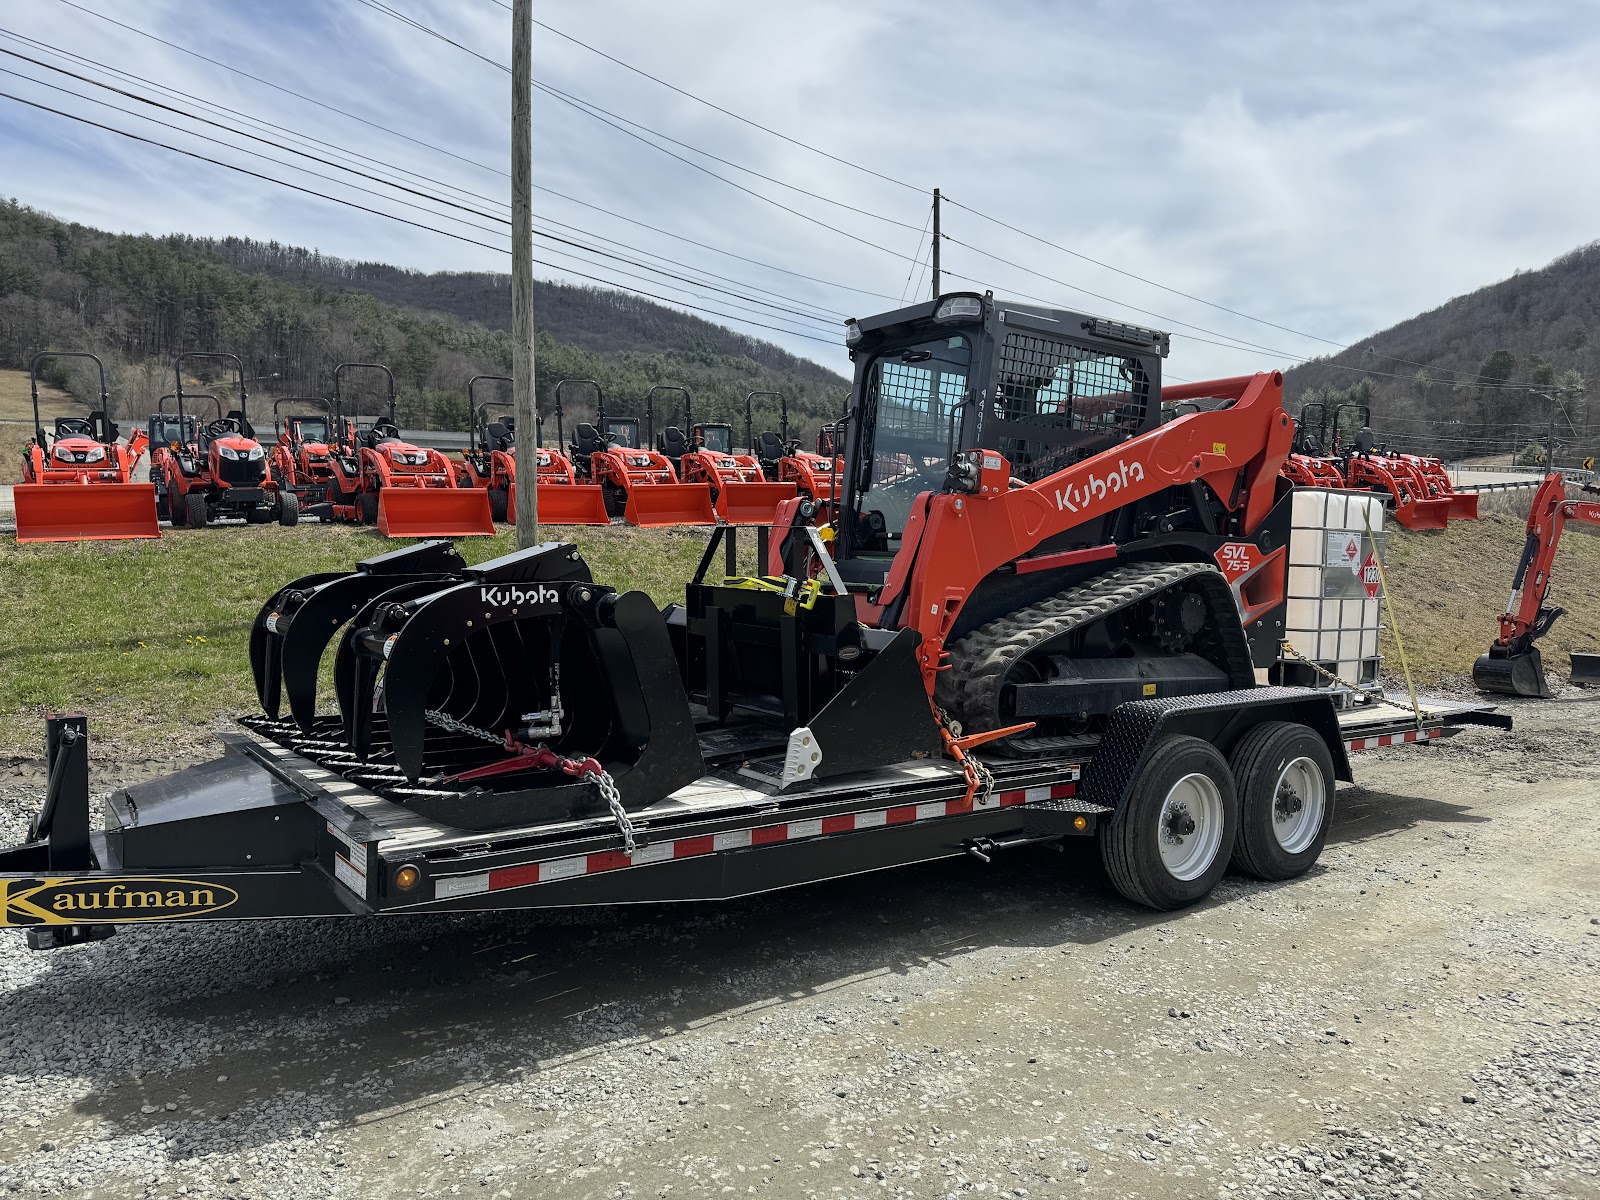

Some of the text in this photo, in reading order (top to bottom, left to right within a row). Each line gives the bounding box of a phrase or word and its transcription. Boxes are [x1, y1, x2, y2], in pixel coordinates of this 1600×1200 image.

[1055, 460, 1145, 513] Kubota
[1222, 545, 1249, 560] SVL
[1226, 560, 1250, 571] 75-3
[481, 584, 559, 606] Kubota
[0, 878, 217, 927] Kaufman
